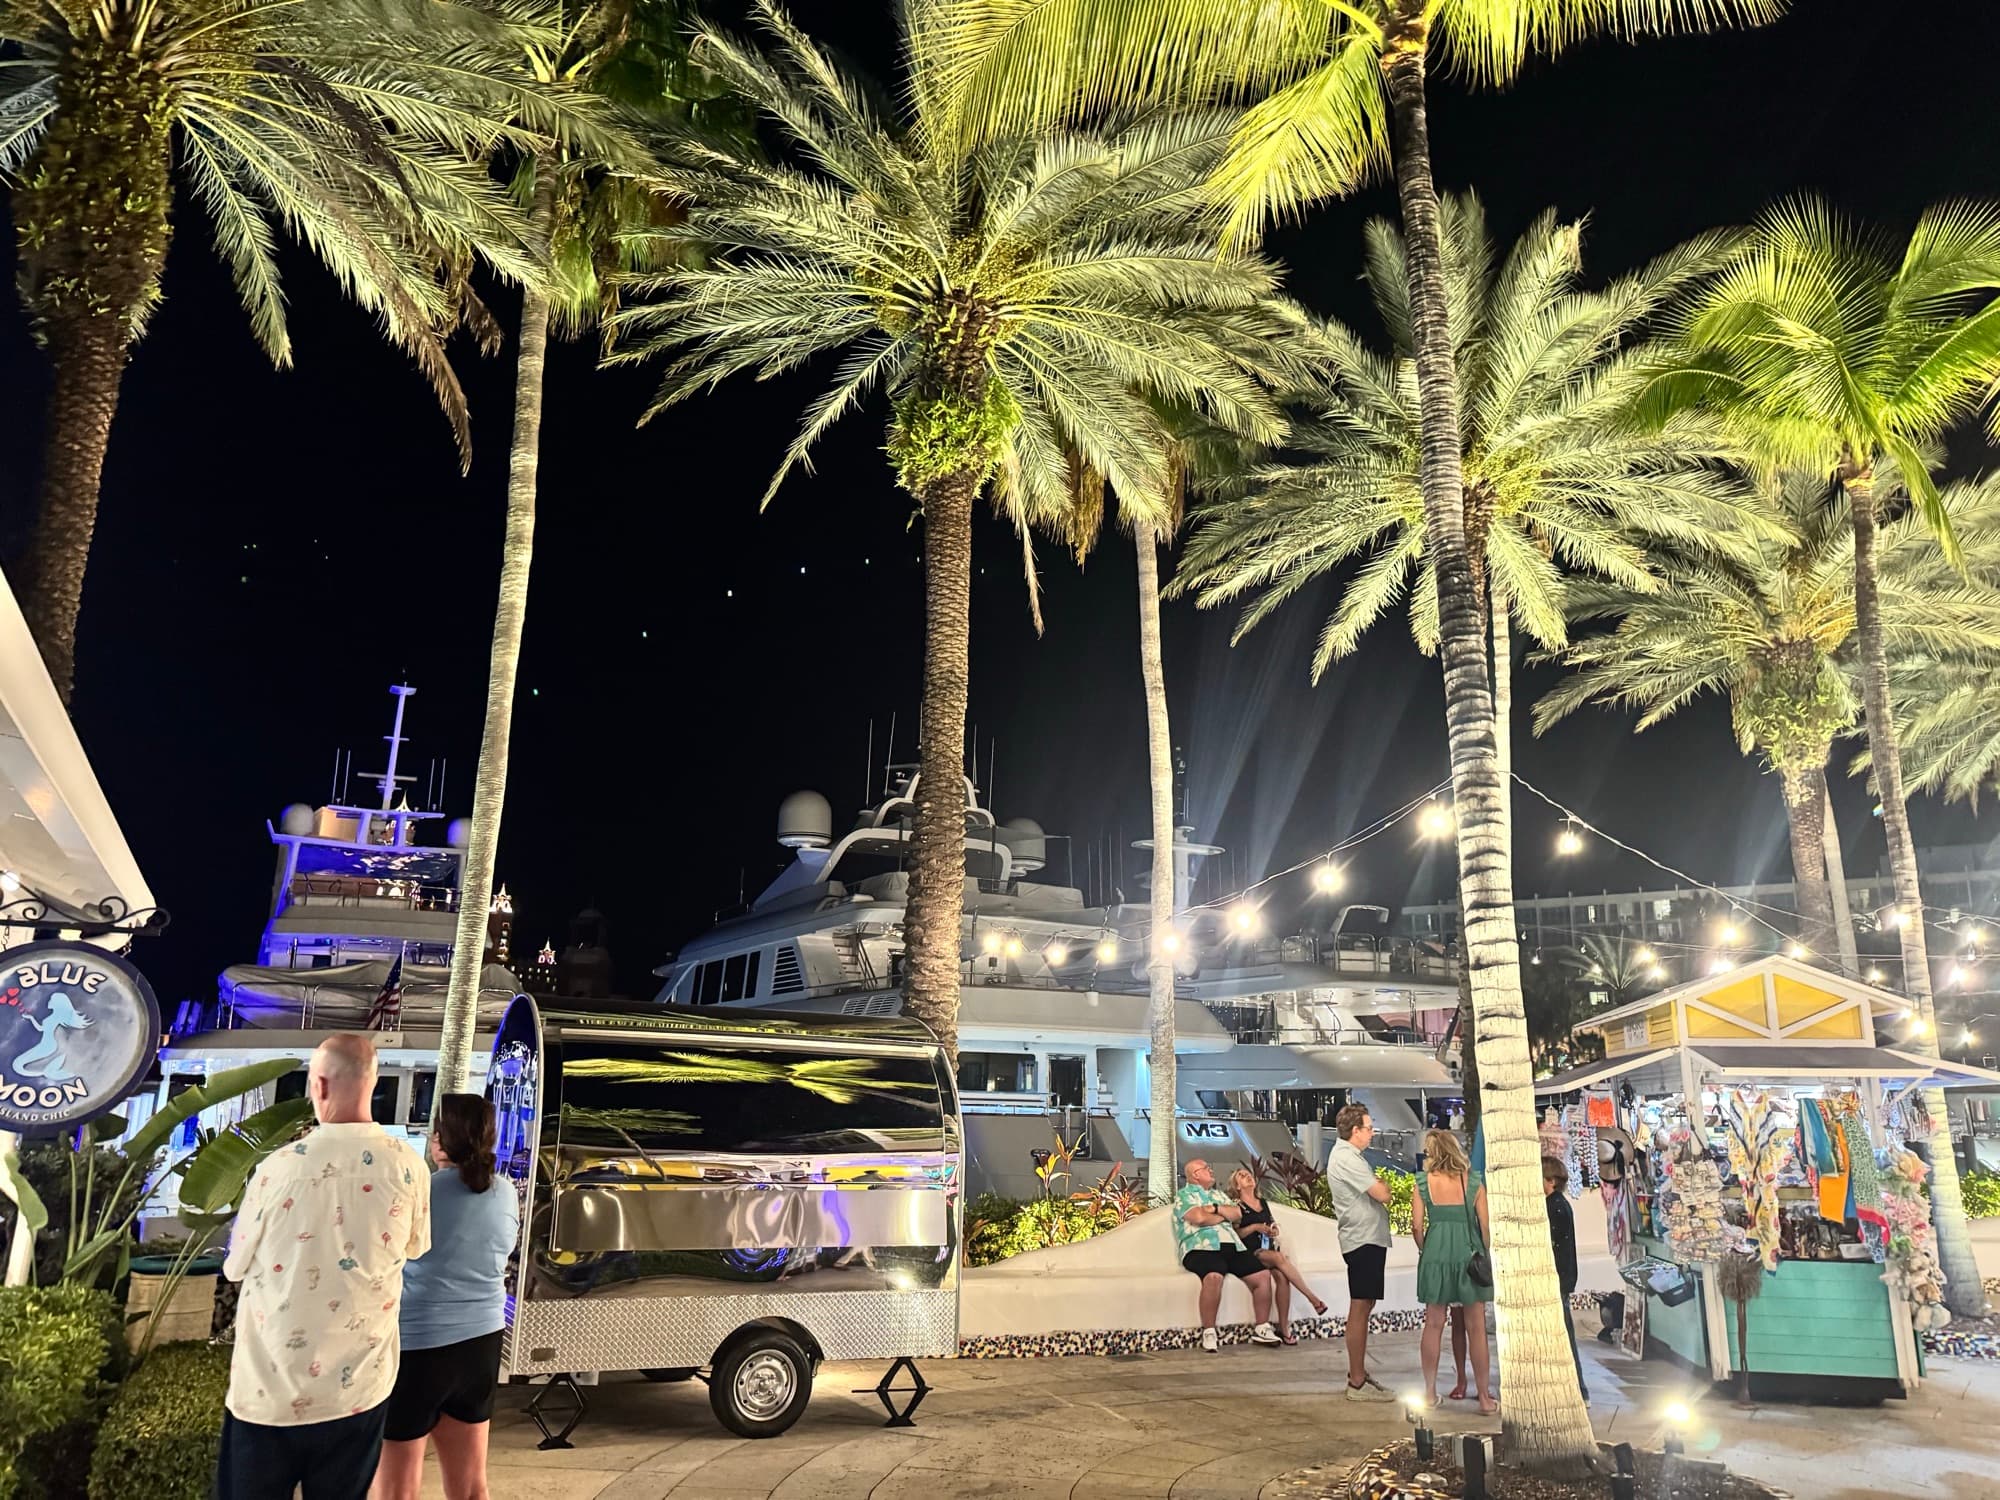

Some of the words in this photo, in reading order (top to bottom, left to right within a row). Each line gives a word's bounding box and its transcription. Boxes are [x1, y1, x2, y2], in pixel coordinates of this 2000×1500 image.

[16, 962, 107, 993] BLUE
[0, 1106, 39, 1121] SLAND
[42, 1108, 71, 1121] CHIC
[1185, 1122, 1230, 1138] M3
